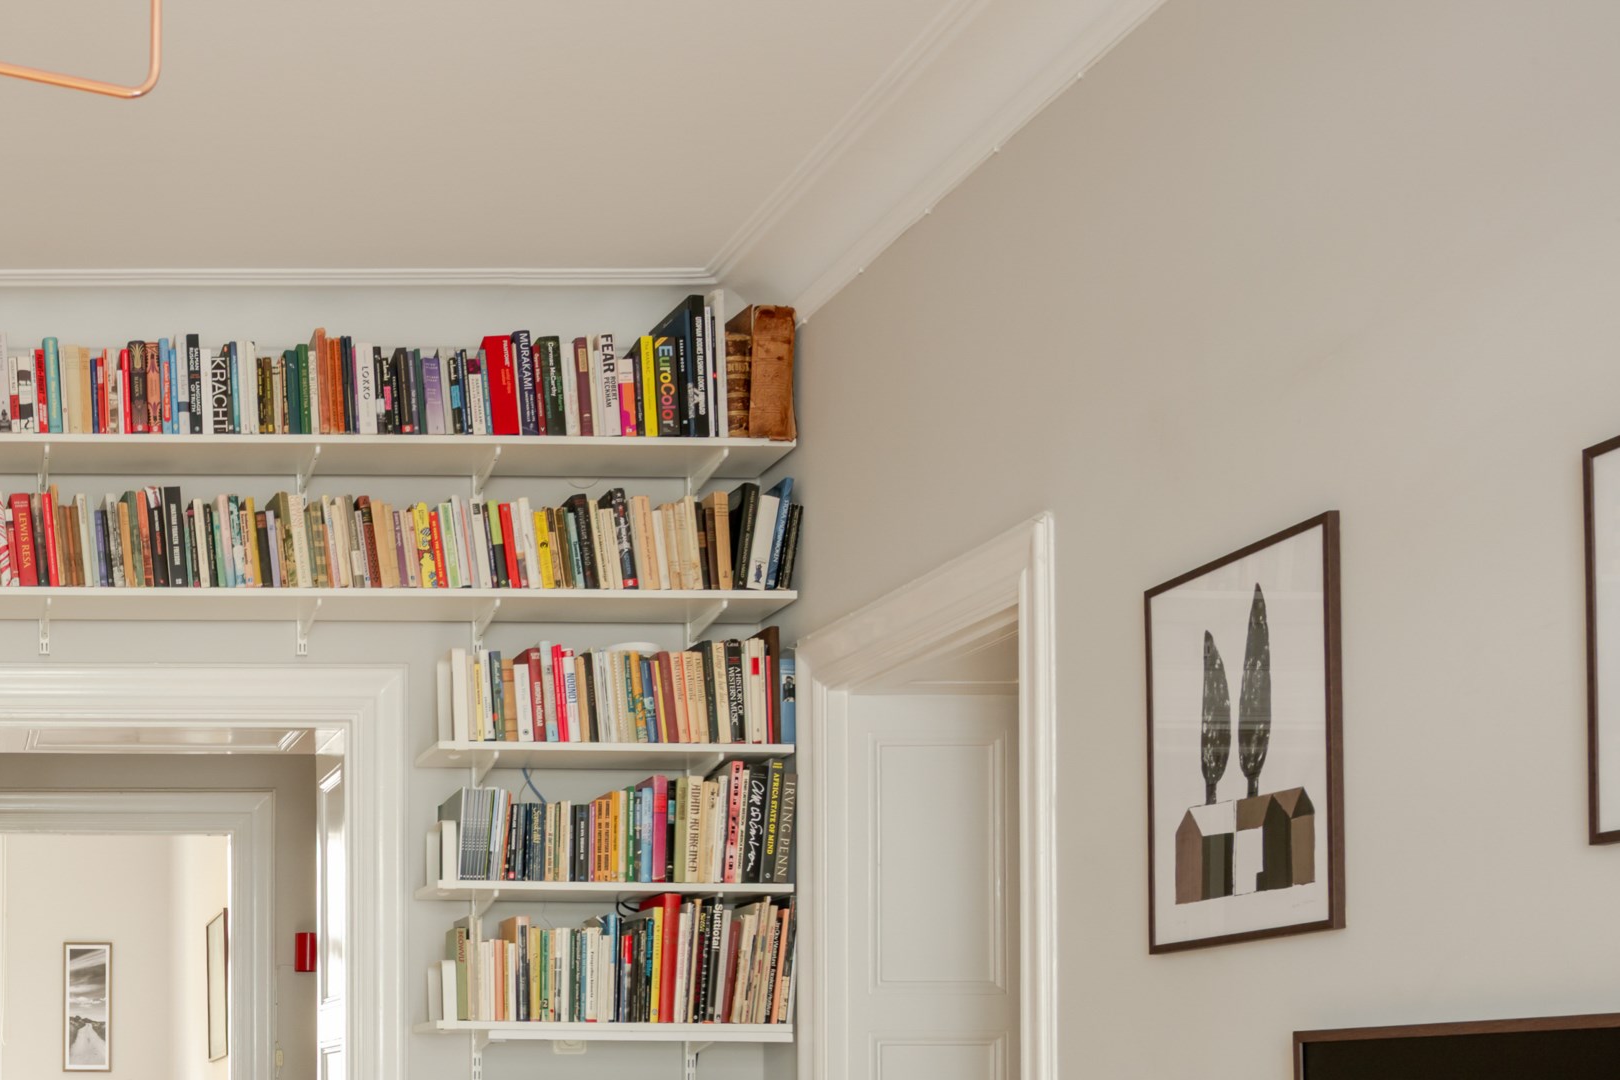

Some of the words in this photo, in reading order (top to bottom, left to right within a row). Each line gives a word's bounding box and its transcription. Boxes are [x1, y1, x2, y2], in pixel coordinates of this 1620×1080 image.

[519, 333, 531, 390] MURAKAMI
[601, 334, 615, 373] FEAR
[212, 357, 228, 429] KRACHT
[361, 366, 371, 400] LOKKO
[658, 345, 676, 426] EuroColor
[18, 512, 29, 542] LEWIS
[780, 499, 789, 518] STORA
[21, 544, 31, 568] RESA
[773, 520, 786, 563] MUMINBOKEN
[567, 672, 577, 704] LONDON
[771, 772, 780, 799] AFRICA
[782, 782, 796, 833] IRVING
[777, 838, 788, 877] PENN
[711, 903, 723, 950] Sjuttiotal
